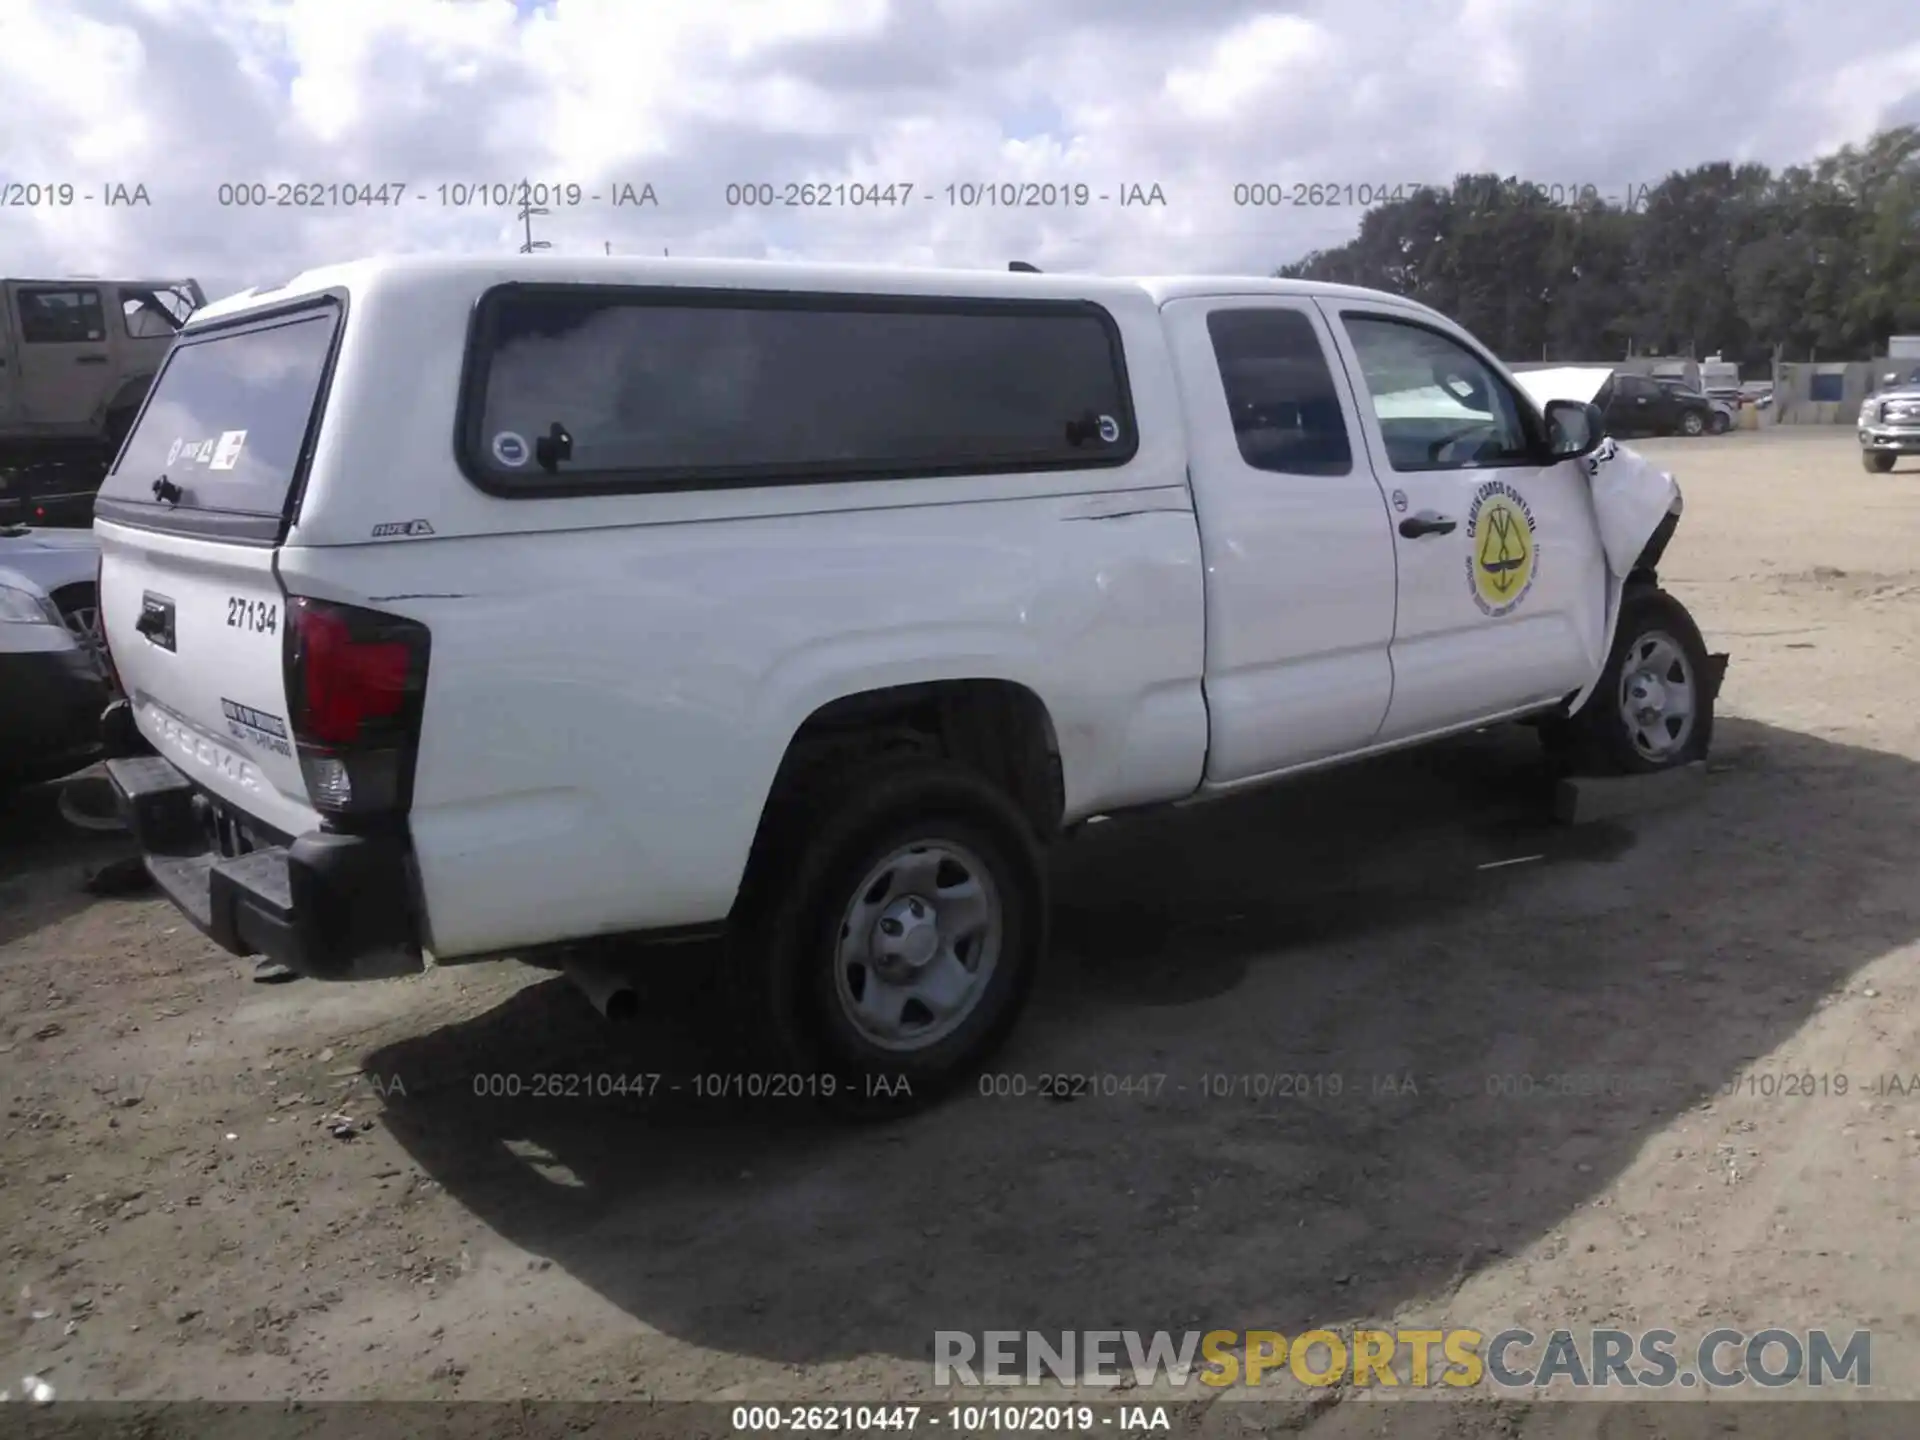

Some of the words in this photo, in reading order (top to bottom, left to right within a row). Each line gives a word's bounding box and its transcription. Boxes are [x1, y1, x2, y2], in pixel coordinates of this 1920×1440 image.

[1478, 480, 1505, 501] CARGO
[1505, 484, 1538, 534] CONTROL
[226, 596, 278, 635] 27134
